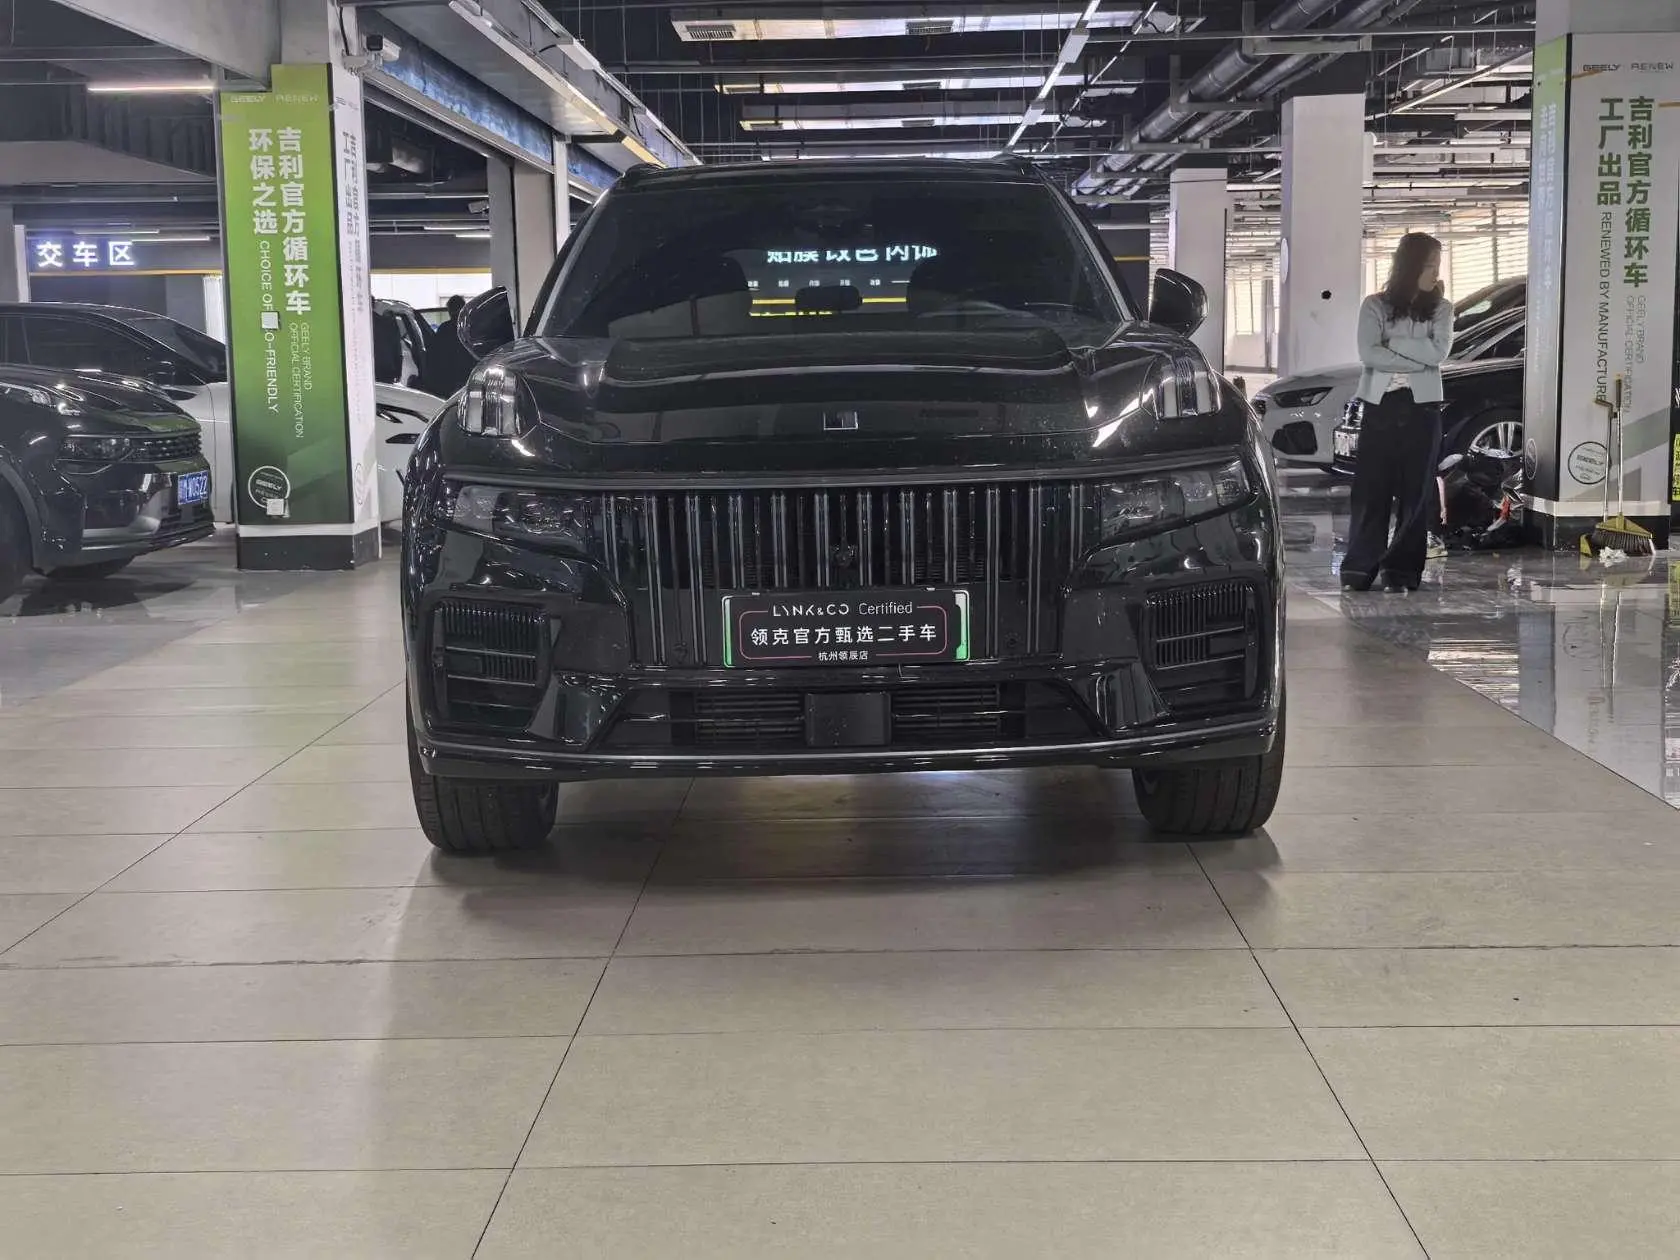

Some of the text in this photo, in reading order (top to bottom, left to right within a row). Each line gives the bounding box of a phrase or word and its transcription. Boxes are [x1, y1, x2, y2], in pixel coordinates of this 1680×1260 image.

[1583, 63, 1674, 72] GEELY RENEW
[1596, 98, 1624, 206] 工厂出品
[248, 128, 278, 235] 环保之选
[1623, 96, 1654, 288] 吉利官方循环车
[277, 127, 312, 315] 吉利官方循环车
[36, 240, 135, 267] 交车区
[1600, 212, 1612, 278] RENEWED
[1599, 284, 1610, 299] BY
[260, 240, 279, 413] CHOICE OF O-FRIENDLY
[303, 356, 312, 390] BRAND
[859, 602, 913, 616] Certified
[751, 624, 936, 646] 领克官方甄选二手车
[818, 651, 868, 661] 杭州领辰店
